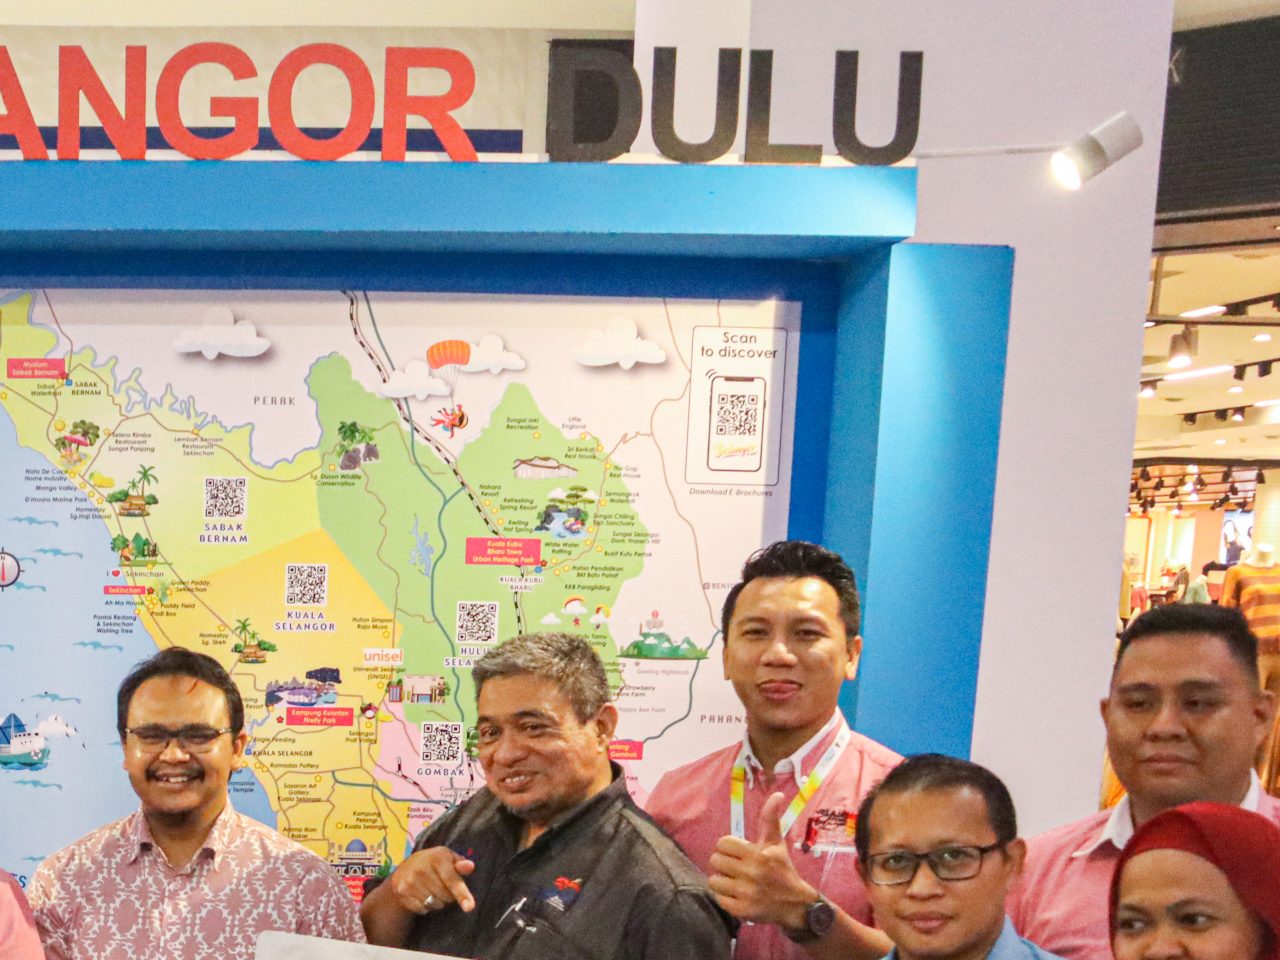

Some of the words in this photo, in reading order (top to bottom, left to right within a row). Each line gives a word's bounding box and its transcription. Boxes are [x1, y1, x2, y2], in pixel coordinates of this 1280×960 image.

[546, 39, 924, 164] DULU
[723, 332, 757, 343] Scan
[701, 345, 714, 357] to
[718, 346, 778, 359] discover
[204, 523, 243, 531] SABAK
[199, 534, 248, 542] BERNAM
[287, 611, 325, 619] KUALA
[275, 622, 336, 630] SELANGOR
[364, 650, 403, 662] unisel
[700, 714, 744, 724] PAHAN
